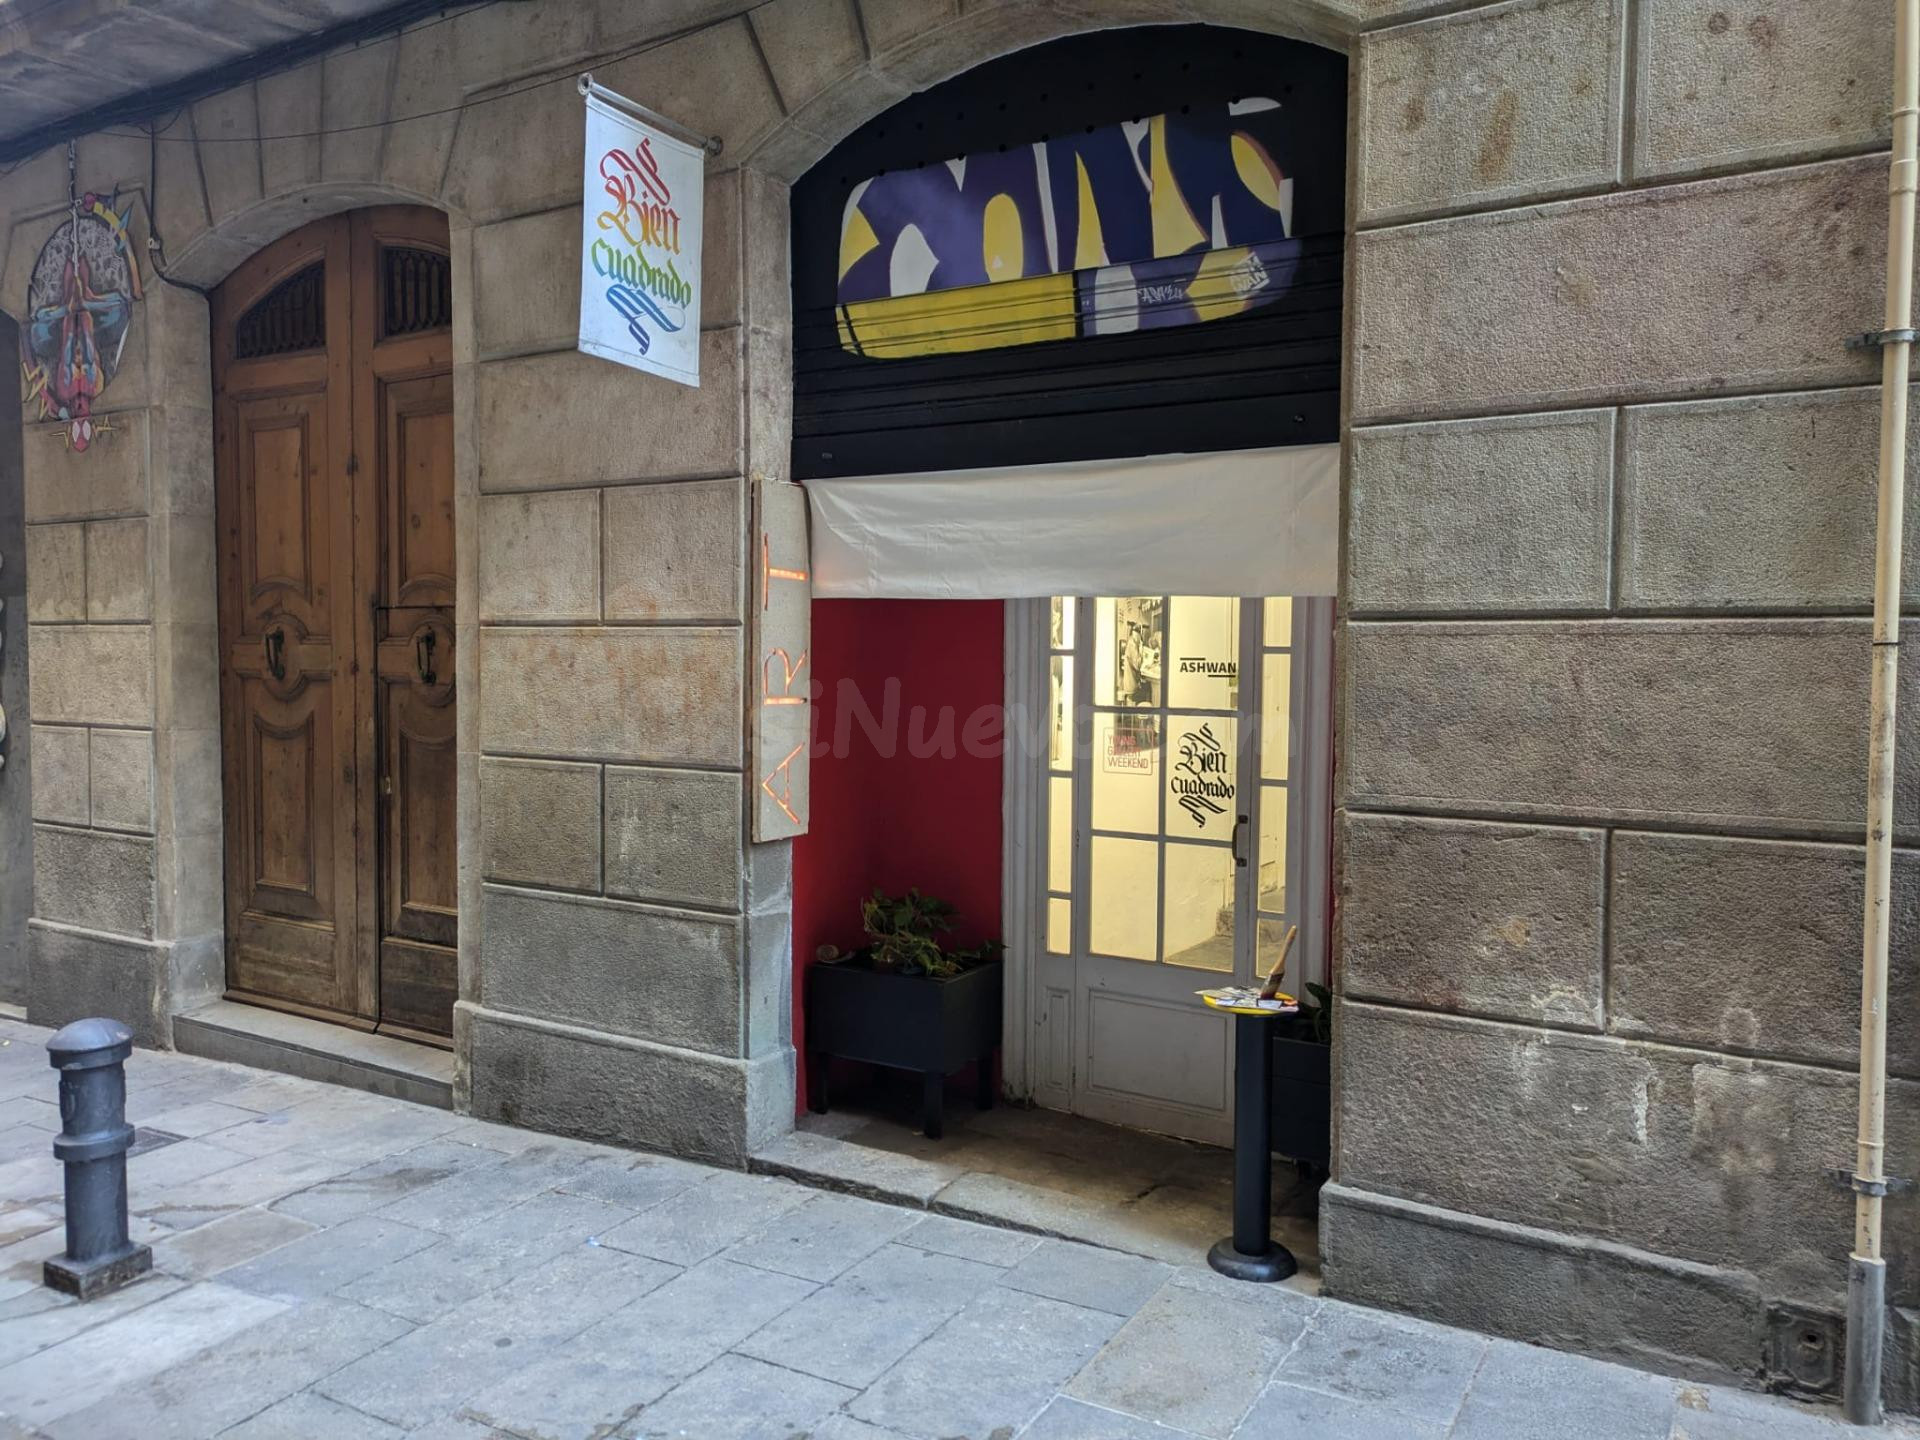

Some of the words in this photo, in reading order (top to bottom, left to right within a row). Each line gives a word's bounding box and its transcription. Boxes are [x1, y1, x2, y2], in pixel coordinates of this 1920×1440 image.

[597, 173, 681, 255] Bien
[763, 532, 807, 825] ART
[1179, 661, 1237, 674] ASHWAN
[1107, 757, 1149, 770] WEEKEND
[1175, 740, 1228, 776] Bien
